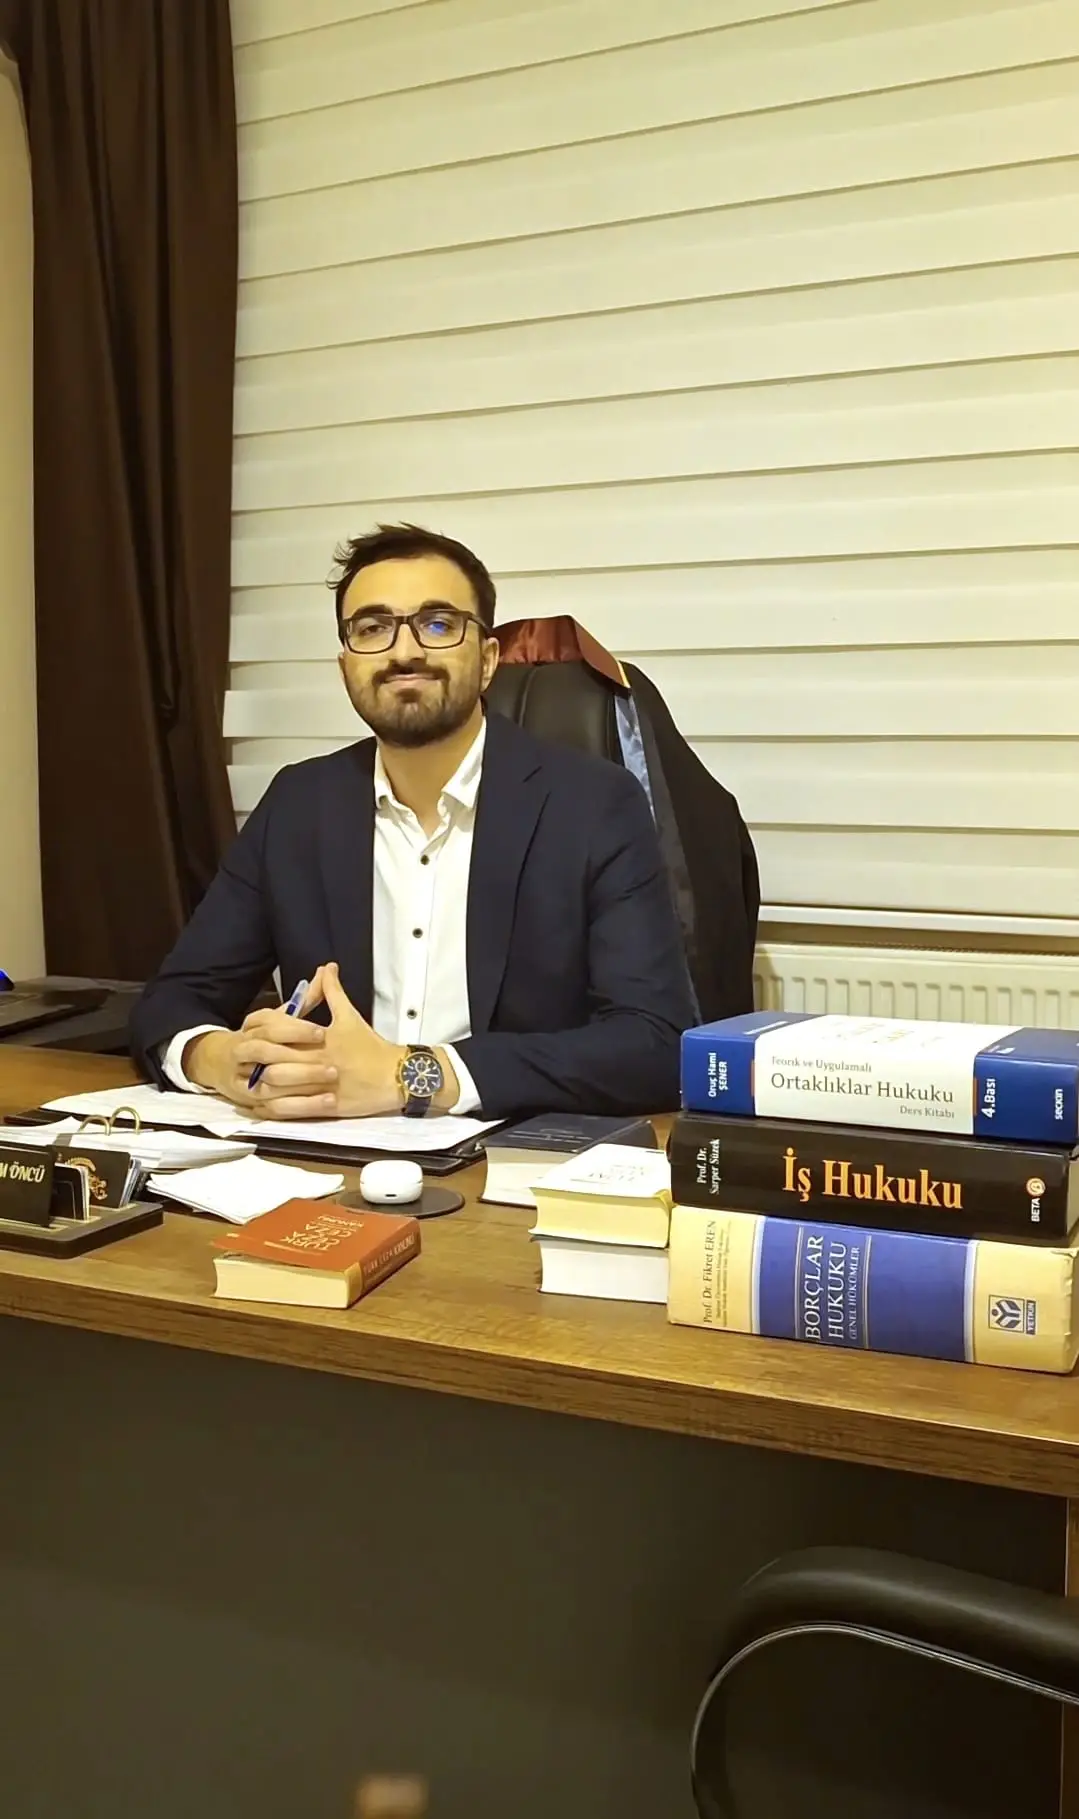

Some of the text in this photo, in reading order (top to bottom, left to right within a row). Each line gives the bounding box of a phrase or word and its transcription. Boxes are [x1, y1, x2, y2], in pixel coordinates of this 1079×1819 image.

[708, 1052, 717, 1097] Oruç Hami
[718, 1061, 728, 1090] ŞENER
[802, 1060, 814, 1068] ve
[815, 1059, 872, 1073] Uygulamalı
[771, 1072, 954, 1104] Ortaklıklar Hukuku
[900, 1105, 955, 1118] Ders Kitabı
[9, 1161, 45, 1183] ÖNCÜ
[696, 1147, 707, 1184] Prof. Dr.
[709, 1139, 721, 1195] Sarper Süzek
[782, 1147, 963, 1209] İş Hukuku
[1031, 1197, 1041, 1222] BETA
[704, 1220, 716, 1251] EREN
[703, 1253, 713, 1282] Fikret
[804, 1235, 824, 1340] BORÇLAR
[827, 1242, 847, 1339] HUKUKU
[848, 1308, 857, 1340] GENEL
